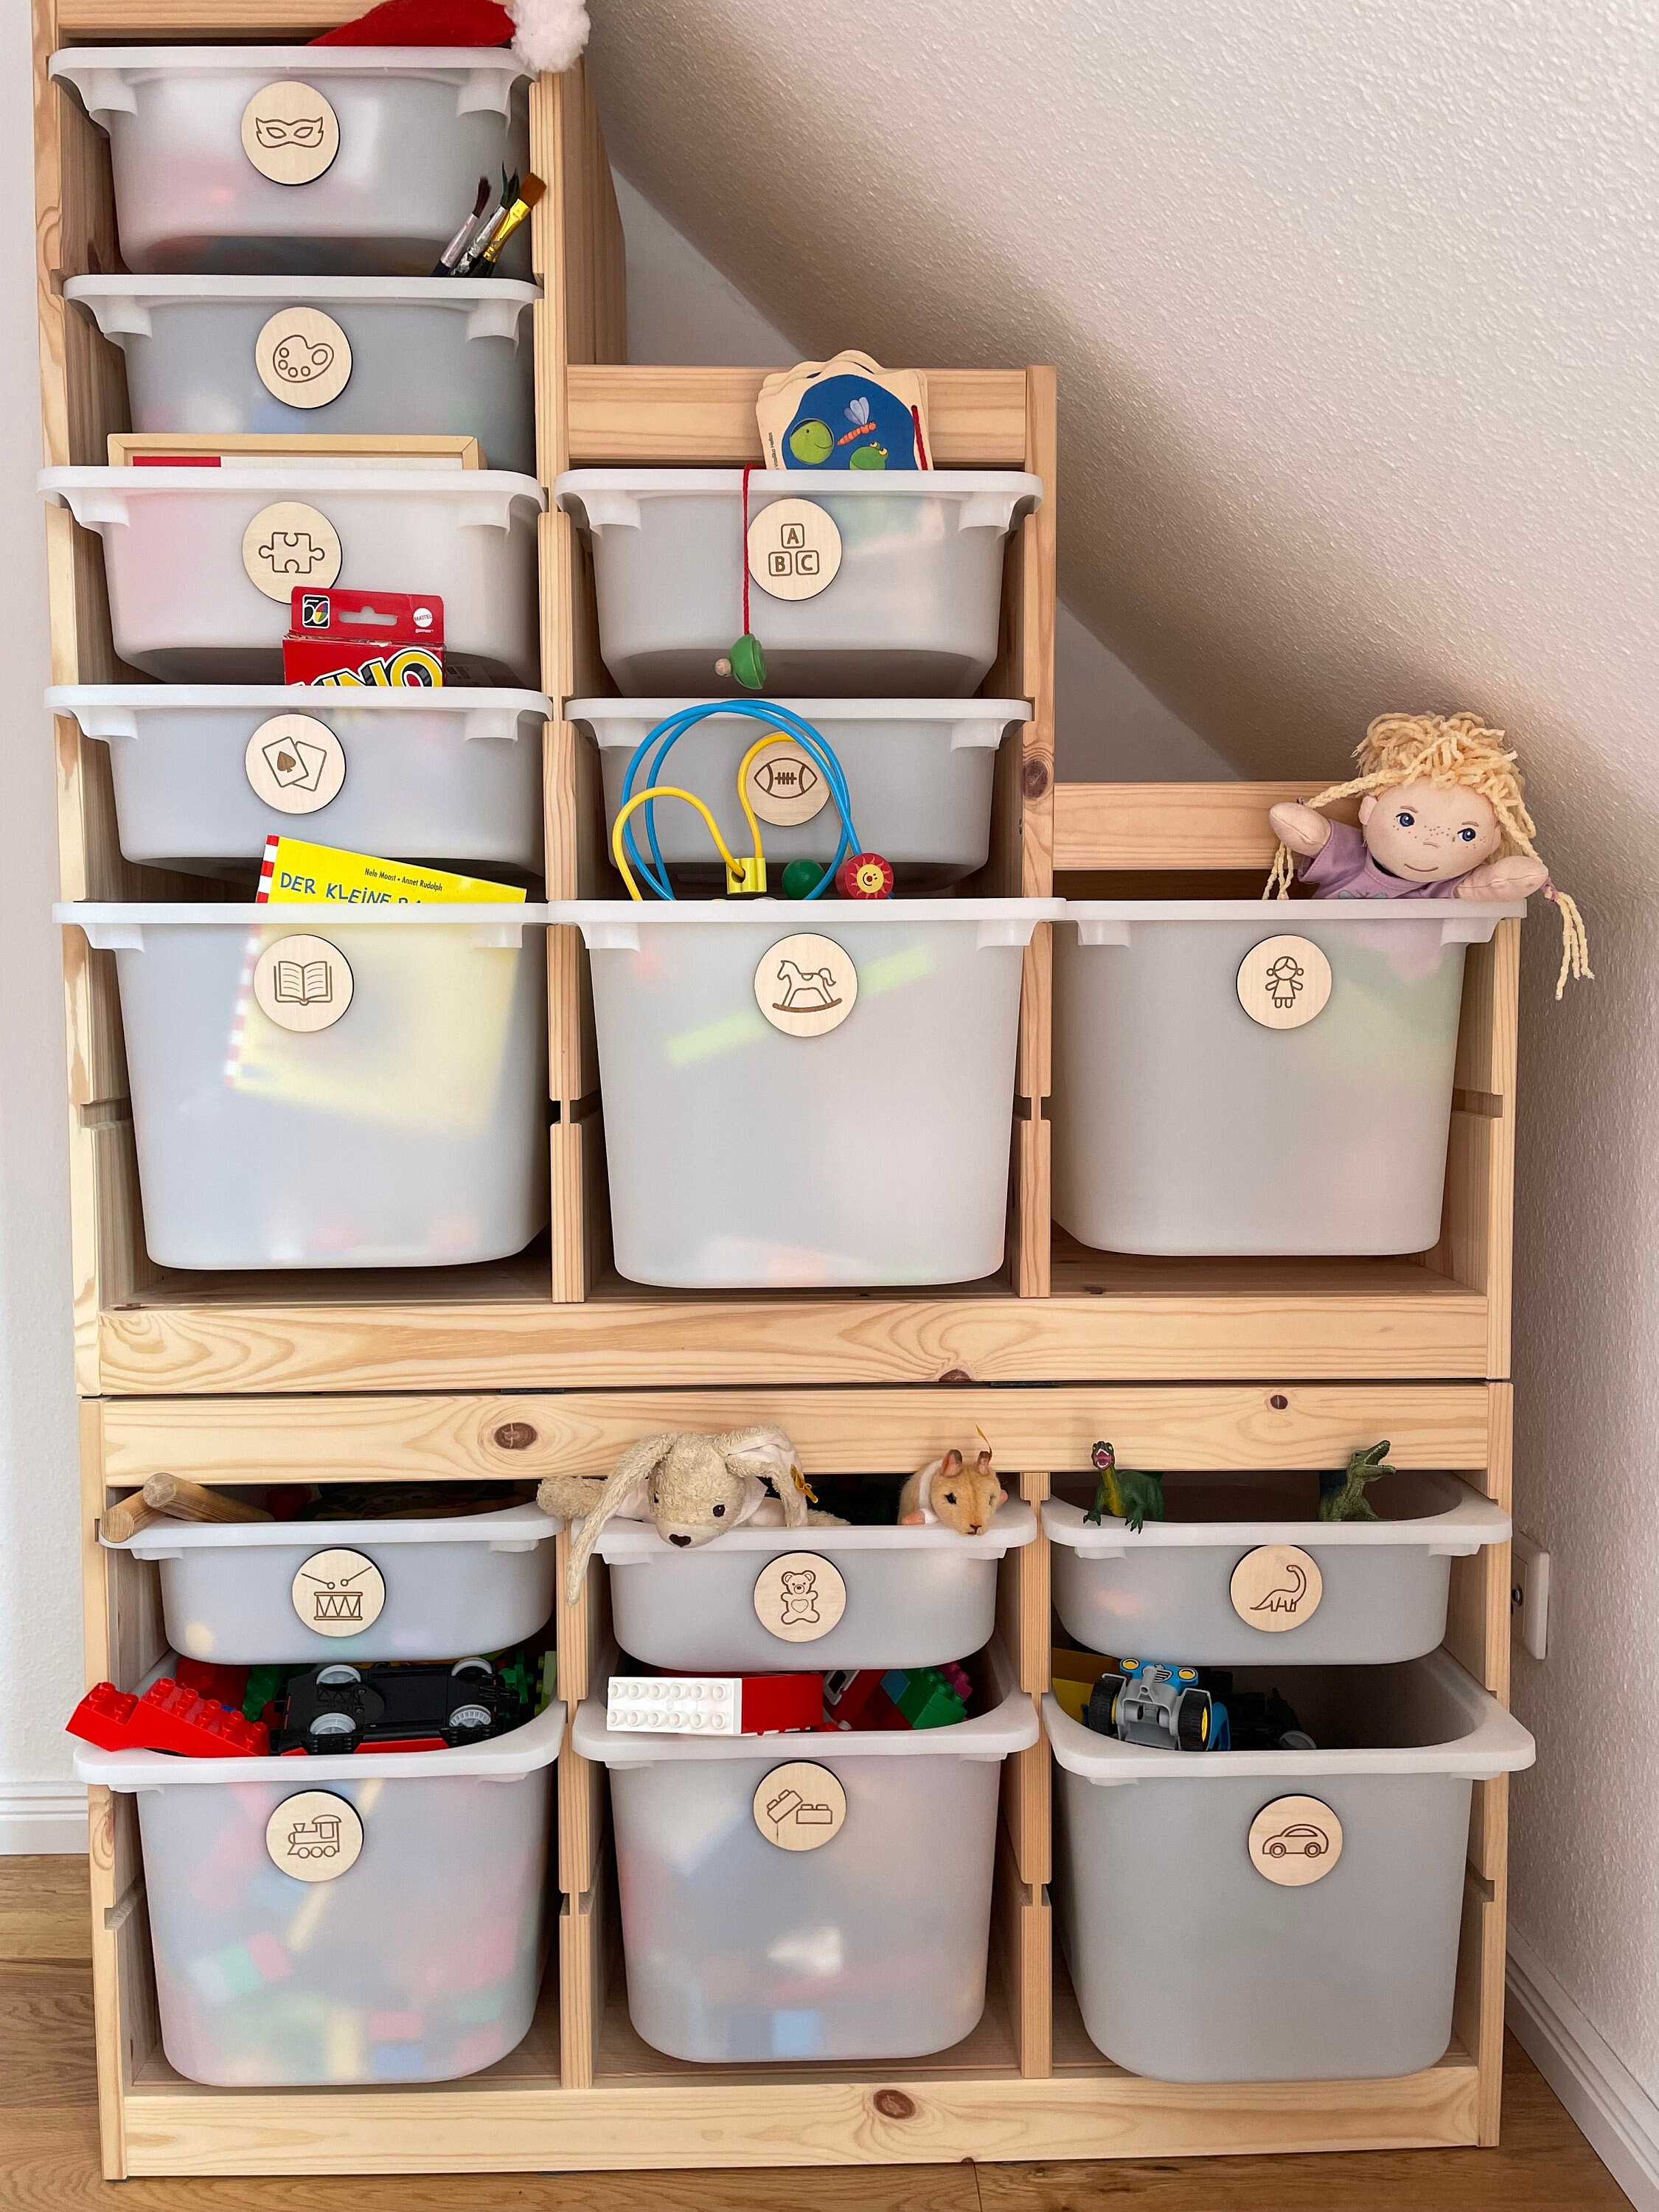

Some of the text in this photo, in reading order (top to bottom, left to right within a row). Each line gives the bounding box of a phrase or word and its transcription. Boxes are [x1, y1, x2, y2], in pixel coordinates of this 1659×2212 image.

[787, 527, 799, 544] A
[775, 554, 813, 572] B C
[414, 613, 433, 622] MATTEL
[280, 872, 316, 894] DER
[364, 867, 443, 892] Nele Moost Annet Rudolph
